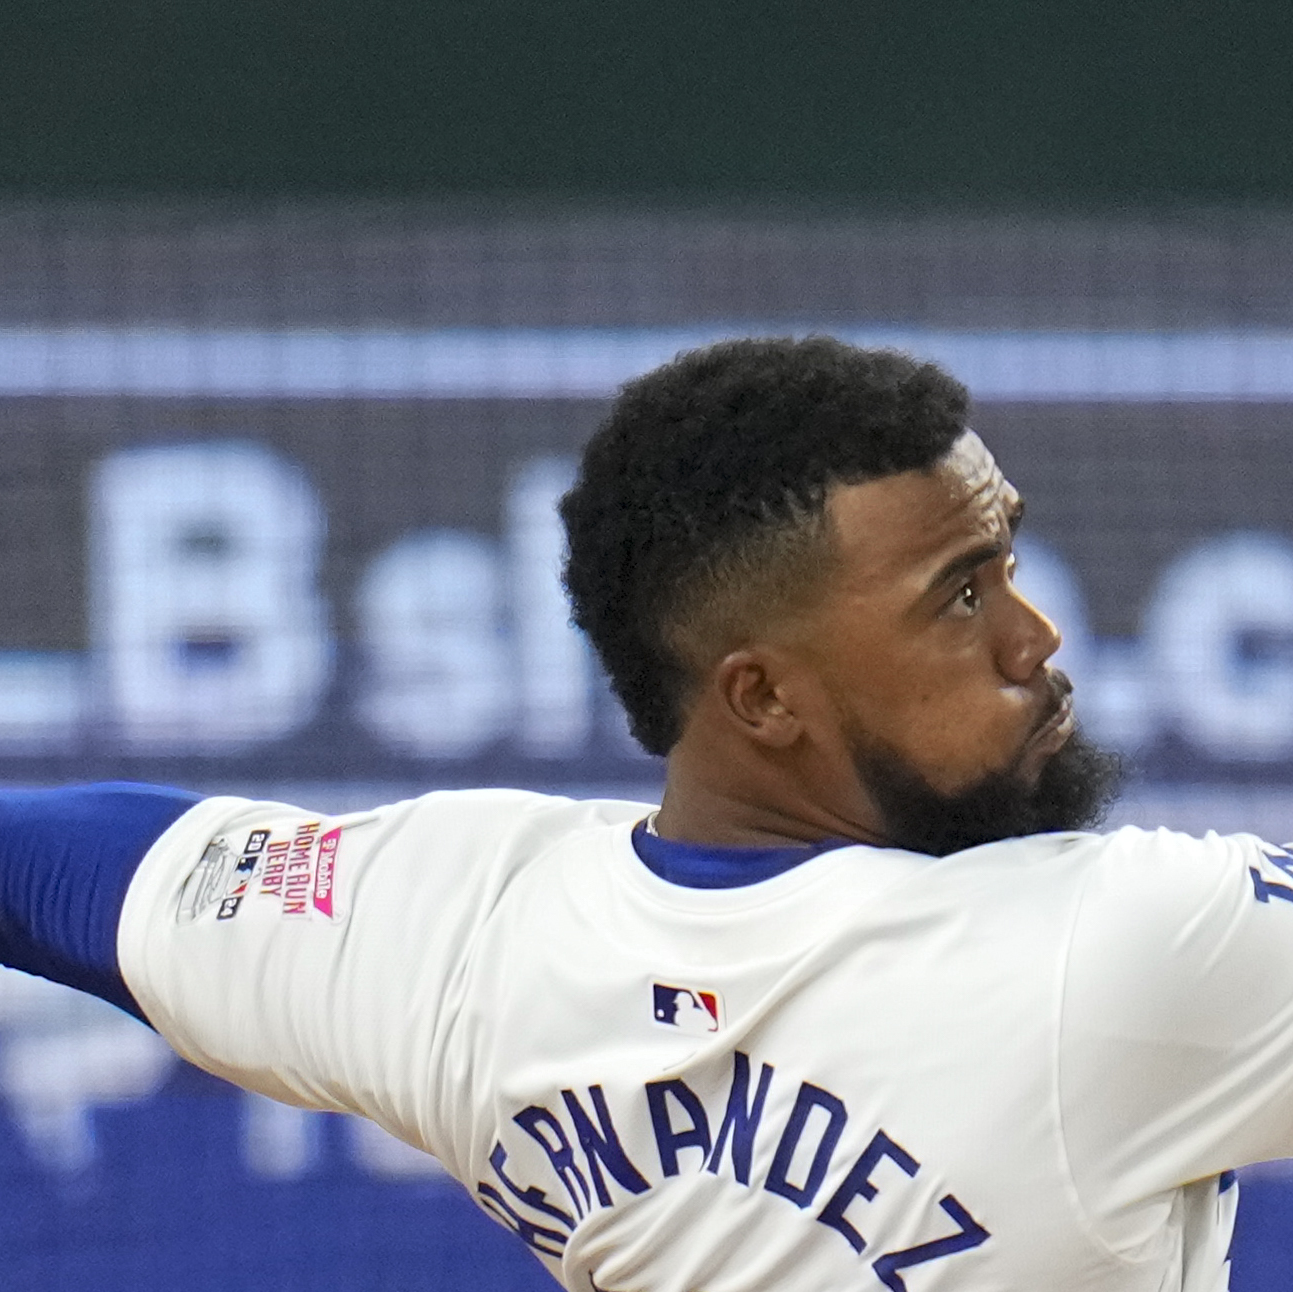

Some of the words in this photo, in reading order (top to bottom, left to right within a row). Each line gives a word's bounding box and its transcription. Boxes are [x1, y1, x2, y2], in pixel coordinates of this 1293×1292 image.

[259, 840, 291, 897] DERBY
[288, 821, 320, 873] HOME
[283, 874, 311, 915] RUN
